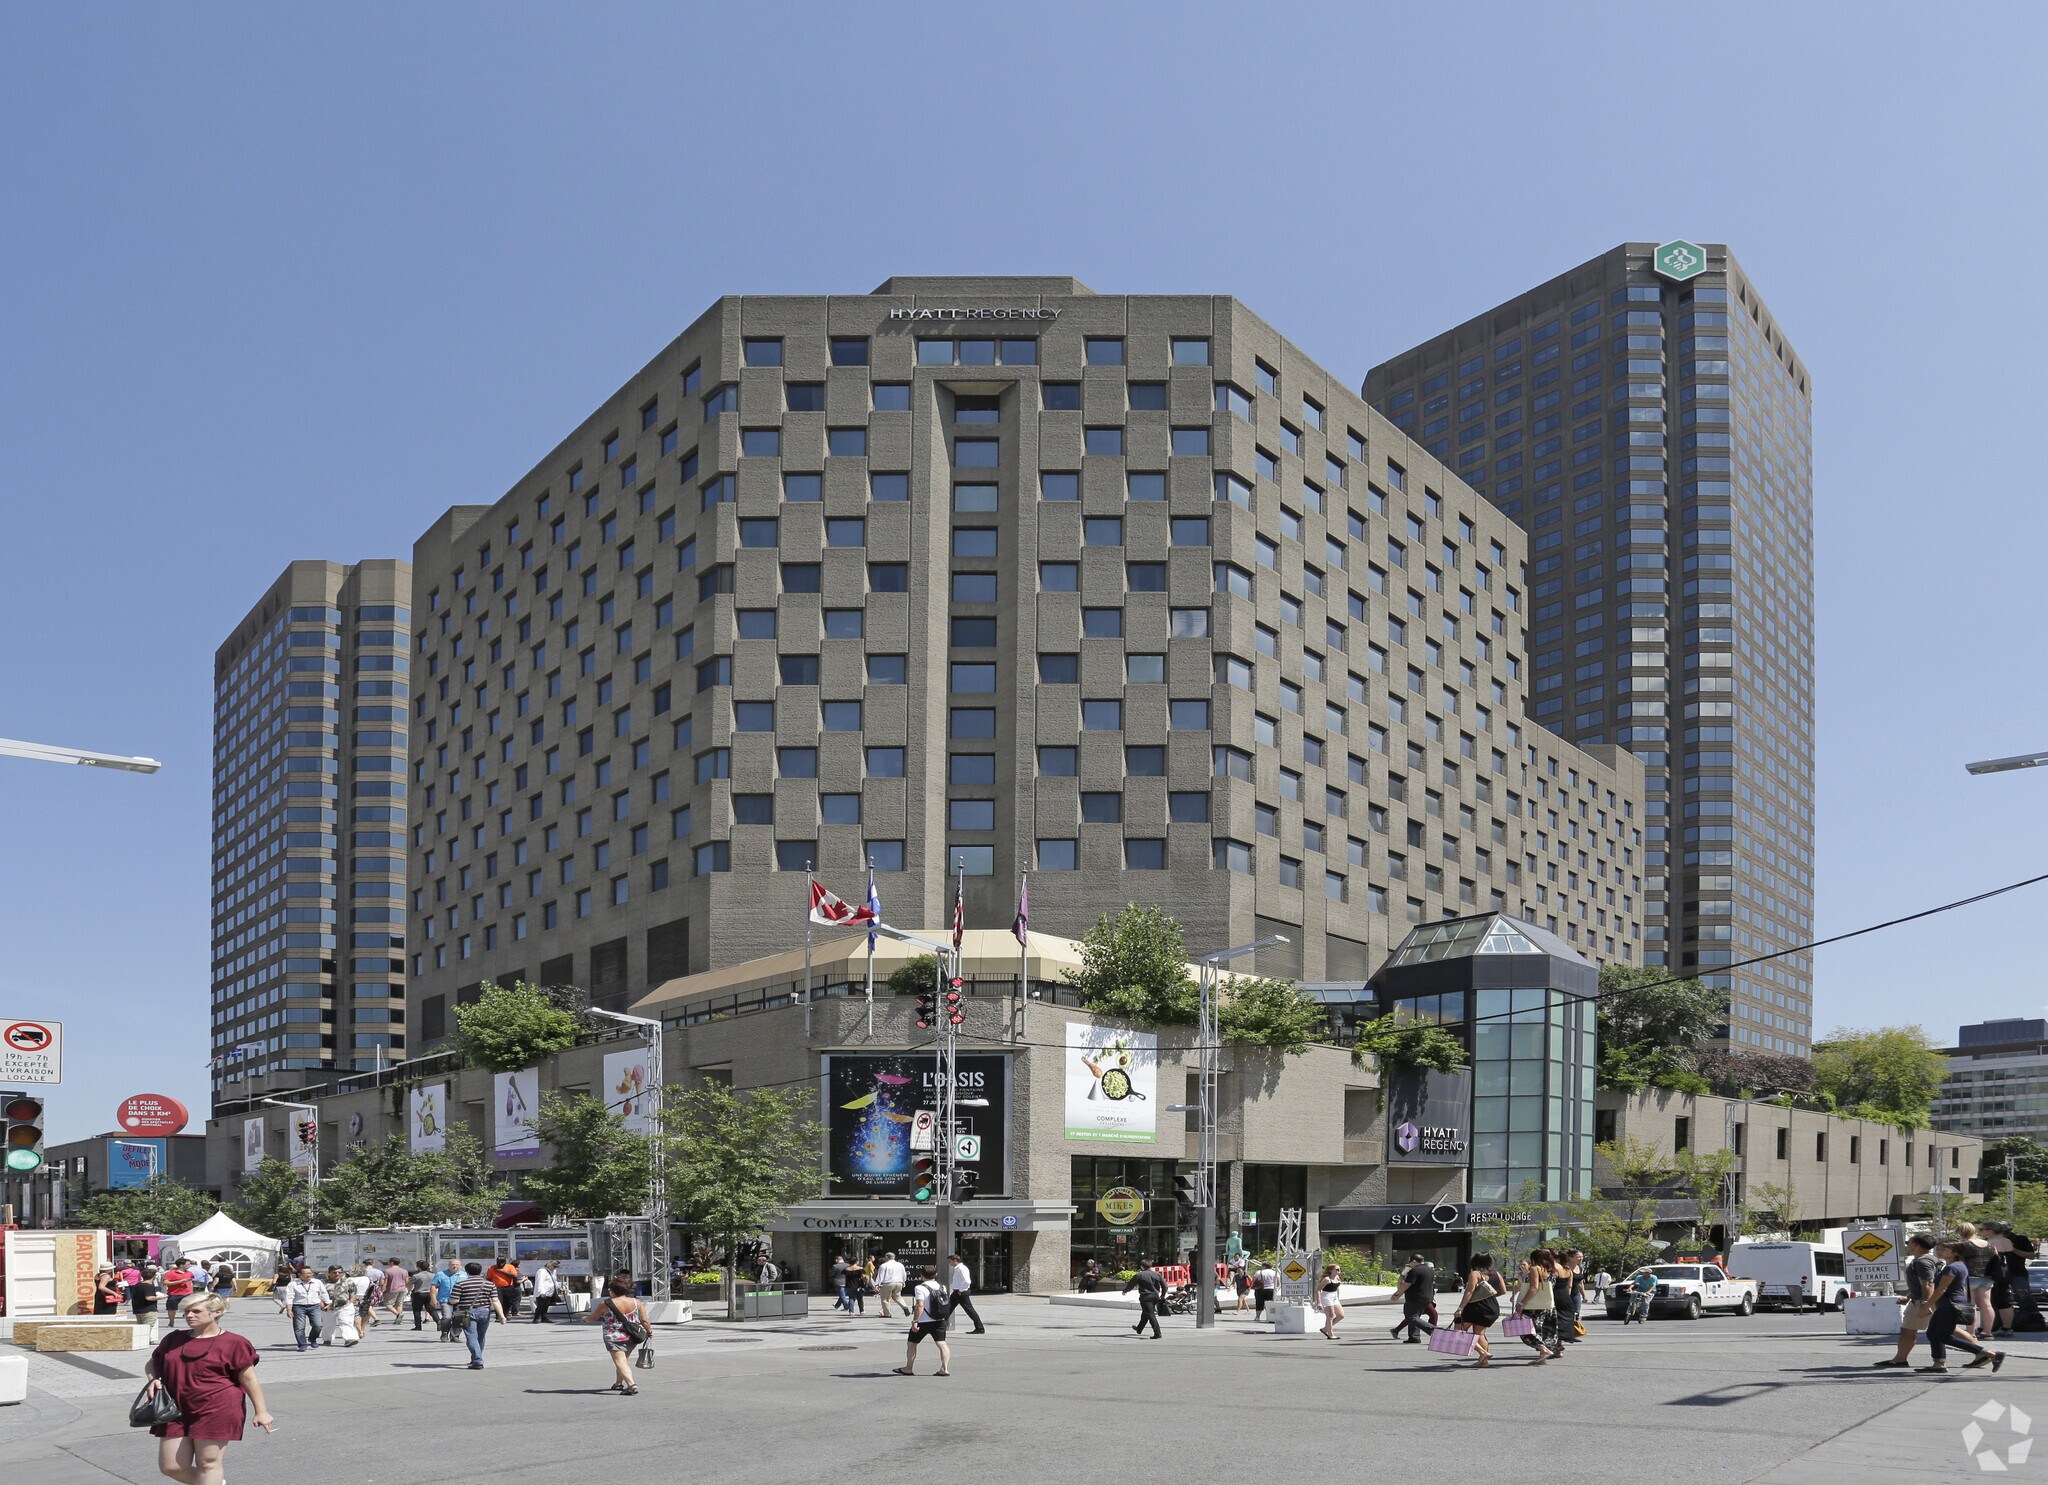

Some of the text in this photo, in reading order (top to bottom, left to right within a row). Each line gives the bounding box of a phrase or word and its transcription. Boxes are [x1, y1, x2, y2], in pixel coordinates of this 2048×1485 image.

[890, 308, 1062, 319] HYATT REGENCY
[0, 1067, 54, 1075] LIVRAISON
[1424, 1127, 1458, 1138] HYATT
[1424, 1138, 1469, 1150] REGENCY
[128, 1160, 151, 1169] MODE
[1105, 1202, 1134, 1210] MIKES
[803, 1217, 999, 1228] COMPLEXE DESJRDINS
[1391, 1214, 1421, 1225] SIX
[905, 1240, 930, 1248] 110
[76, 1234, 95, 1315] BARCELONA
